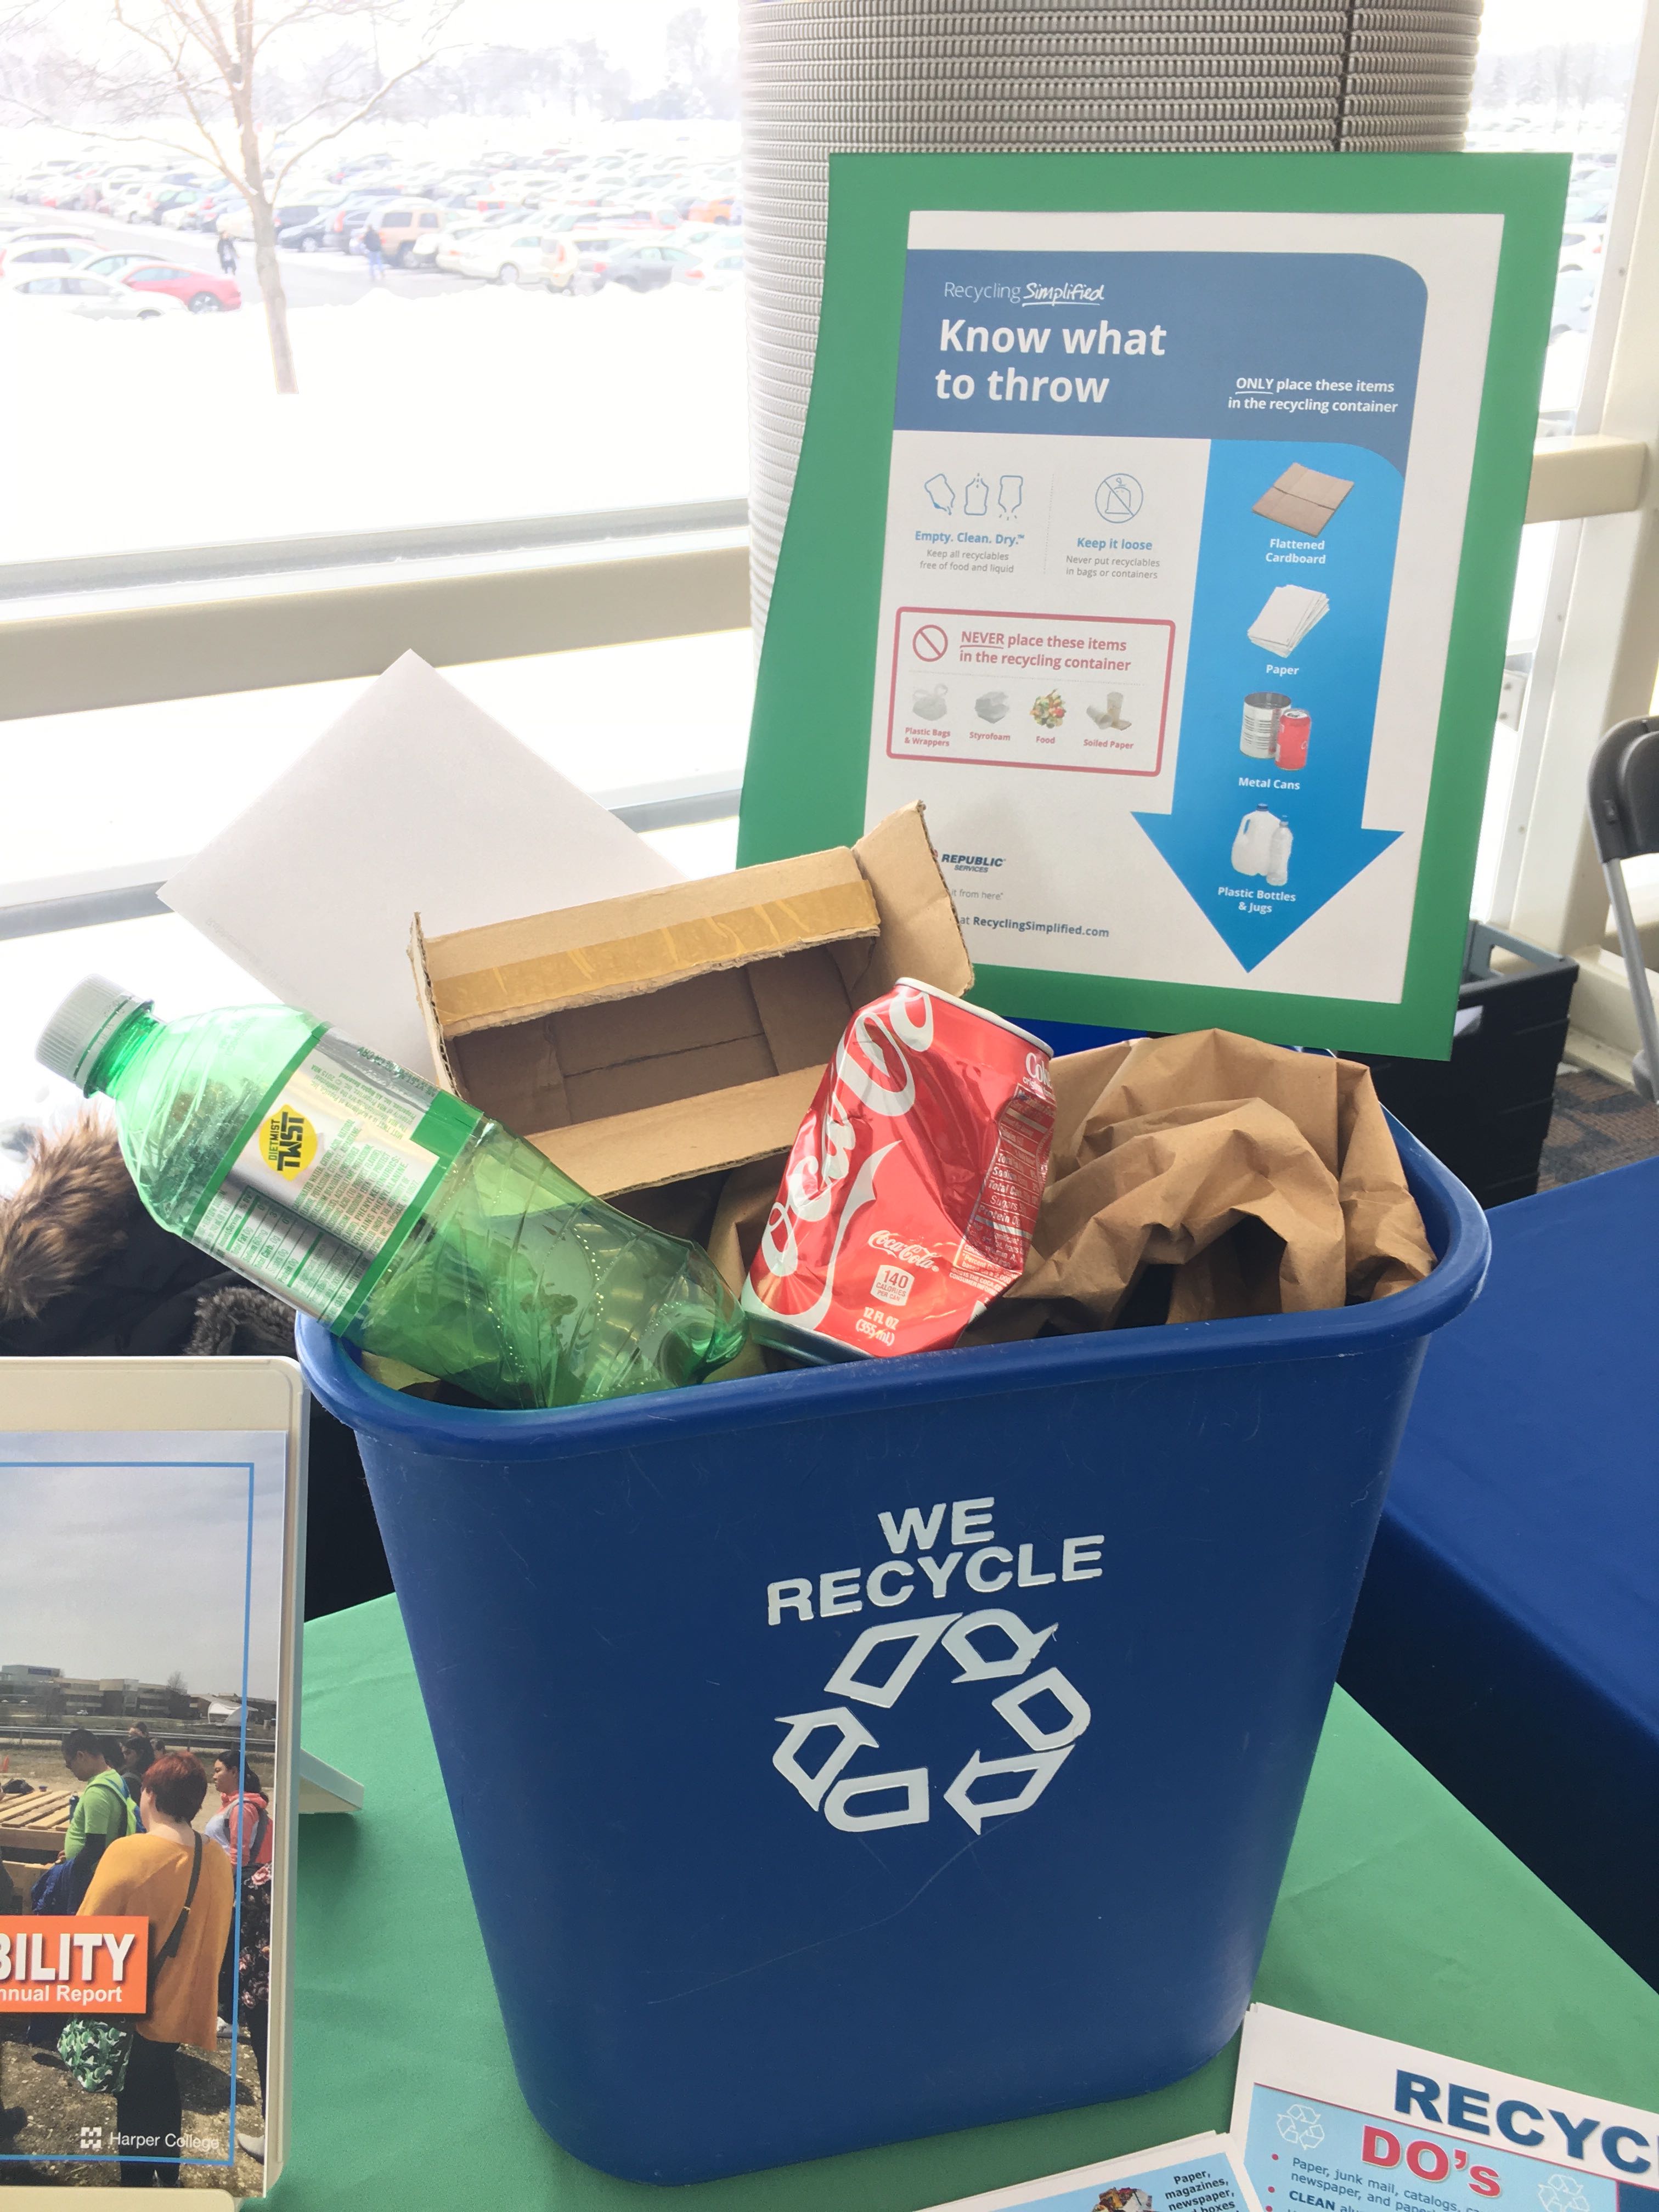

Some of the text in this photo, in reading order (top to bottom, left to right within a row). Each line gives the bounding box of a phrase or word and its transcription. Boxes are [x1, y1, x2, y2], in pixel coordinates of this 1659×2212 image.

[944, 282, 1105, 307] Recycling Simplified
[940, 319, 1167, 356] Know what
[935, 367, 1110, 403] to throw
[1236, 377, 1394, 392] ONLY place these items
[1228, 397, 1398, 414] in the recycling container
[915, 531, 953, 543] Empty.
[957, 532, 992, 544] Clean.
[1077, 538, 1153, 551] Keep it loose
[1269, 539, 1325, 550] Flattened
[926, 549, 1009, 561] Keep all recyclables
[1066, 555, 1160, 568] Never put recyclables
[1265, 552, 1326, 564] Cardboard
[919, 561, 1014, 574] free of food and liquid
[1076, 568, 1097, 578] bags
[1111, 569, 1158, 579] containers
[961, 631, 1127, 652] NEVER place these items
[960, 650, 1131, 672] in the recycling container
[1266, 664, 1299, 676] Paper
[904, 736, 950, 748] & Wrappers
[905, 727, 951, 740] Plastic Bags
[969, 731, 1011, 742] Styrofoam
[1036, 736, 1056, 744] Food
[1084, 738, 1134, 751] Soiled Paper
[1238, 777, 1300, 791] Metal Cans
[954, 865, 989, 873] SERVICES
[959, 889, 979, 899] from
[1217, 887, 1296, 901] Plastic Bottles
[1238, 901, 1272, 915] & Jugs
[960, 916, 1109, 938] at RecyclingSimplified.com
[320, 1070, 335, 1082] 2015
[269, 1119, 280, 1140] MIST
[336, 1117, 355, 1140] NATURAL
[373, 1150, 391, 1174] PROTECT
[338, 1195, 351, 1209] ACID
[351, 1166, 369, 1189] PROTECT
[354, 1151, 401, 1224] PHENYLKETONURICS:
[351, 1158, 409, 1246] CONTAINS PHENYLALANINE.
[370, 1215, 385, 1233] UNDER
[380, 1206, 391, 1217] THE
[978, 1205, 1010, 1223] Protein
[237, 1225, 254, 1244] Fat 0g
[251, 1227, 269, 1247] 60mg
[260, 1234, 281, 1259] Carb. 0g
[276, 1256, 300, 1284] Protein 0g
[884, 1269, 909, 1289] 140
[876, 1282, 907, 1297] CALORIES
[877, 1290, 901, 1302] PER CAN
[856, 1318, 878, 1334] (355
[863, 1306, 899, 1330] 12 FL OZ
[878, 1497, 994, 1554] WE
[767, 1534, 1104, 1626] RECYCLE
[57, 1985, 122, 2005] Report
[1394, 2069, 1659, 2176] RECYC
[110, 2132, 219, 2151] Harper College
[1173, 2170, 1211, 2185] Paper,
[1293, 2157, 1460, 2212] Paper, junk mail, catalogs,
[1165, 2178, 1229, 2200] magazines,
[1291, 2171, 1362, 2201] newspaper,
[1367, 2192, 1391, 2207] and
[1168, 2189, 1235, 2211] newspaper,
[1289, 2190, 1336, 2211] CLEAN
